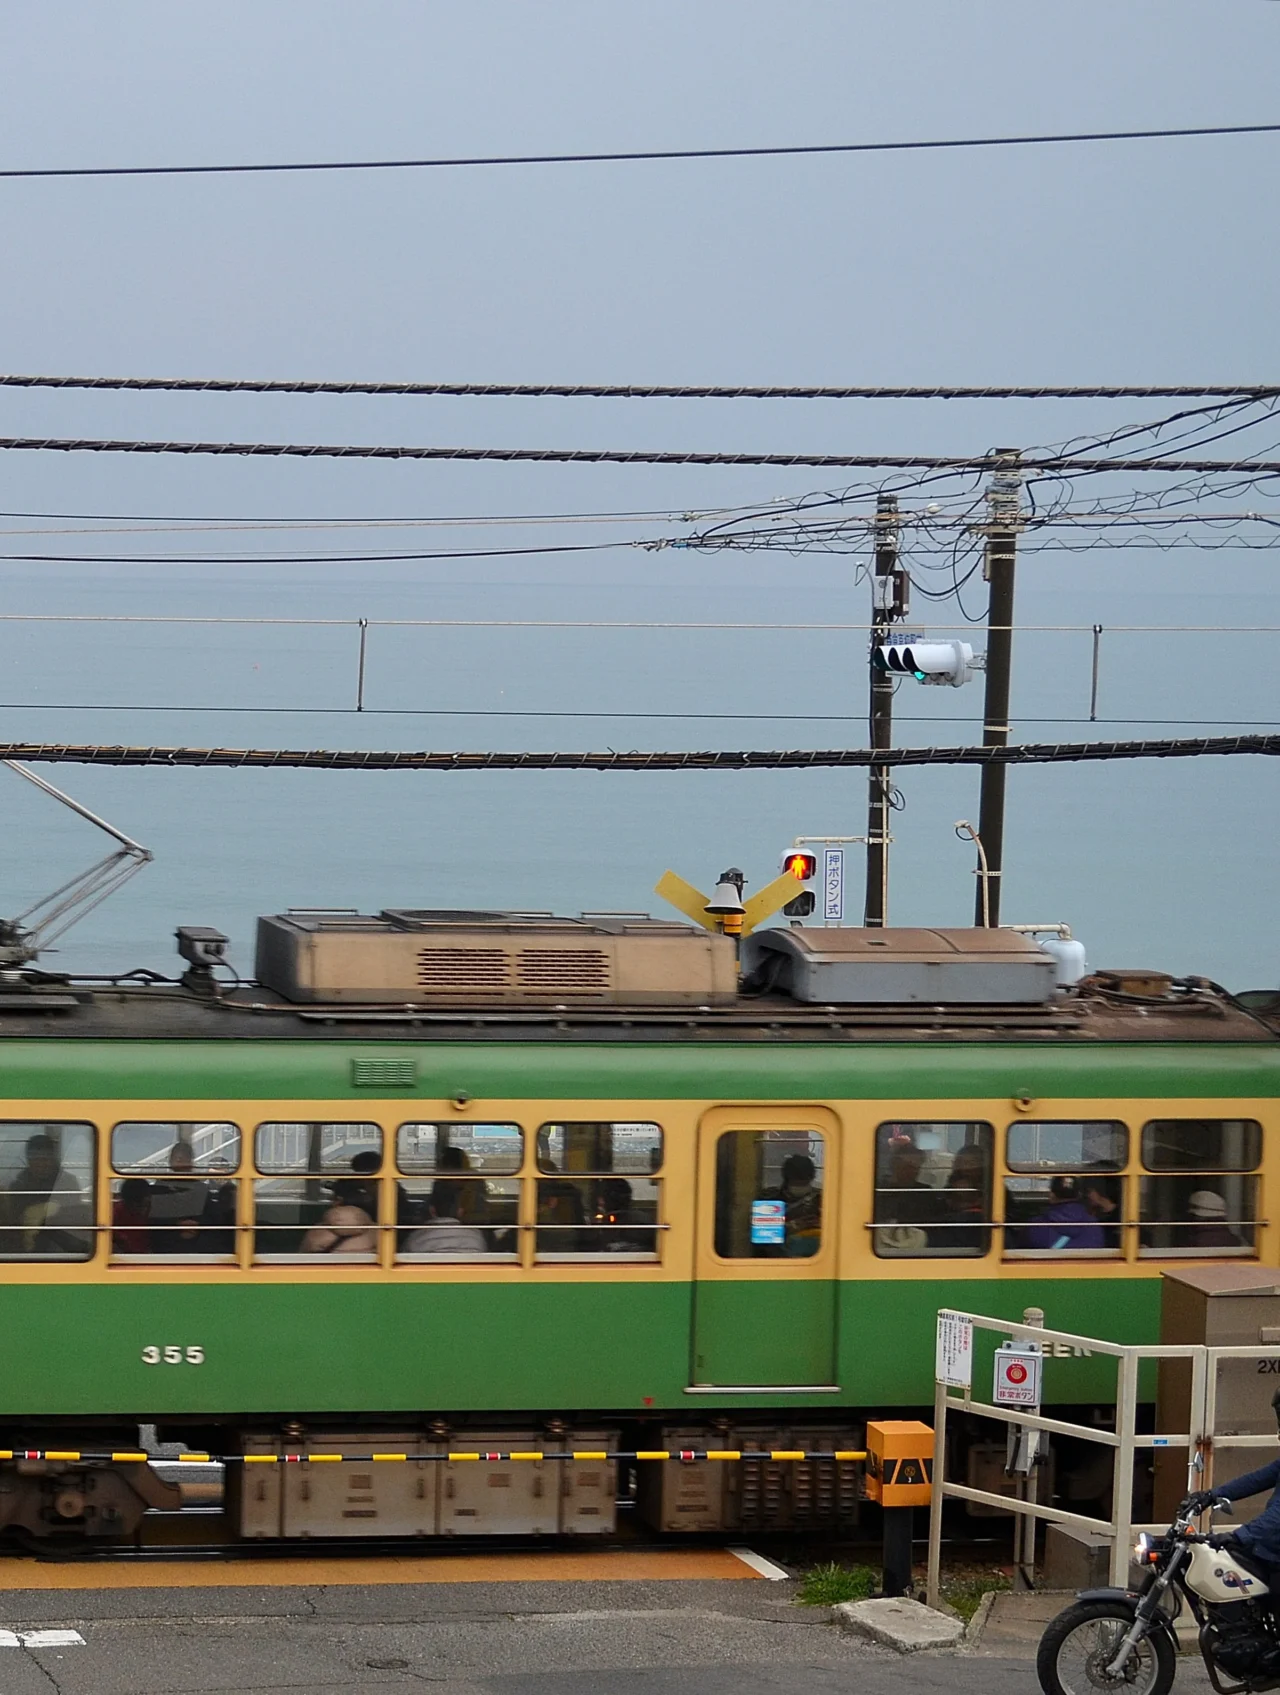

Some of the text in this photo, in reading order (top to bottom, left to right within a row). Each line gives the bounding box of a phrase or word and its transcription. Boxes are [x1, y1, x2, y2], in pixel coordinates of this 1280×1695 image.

[827, 853, 840, 915] 押ボタン式
[141, 1345, 205, 1365] 355
[1257, 1360, 1280, 1374] 2X
[999, 1390, 1033, 1401] 非常ボタン
